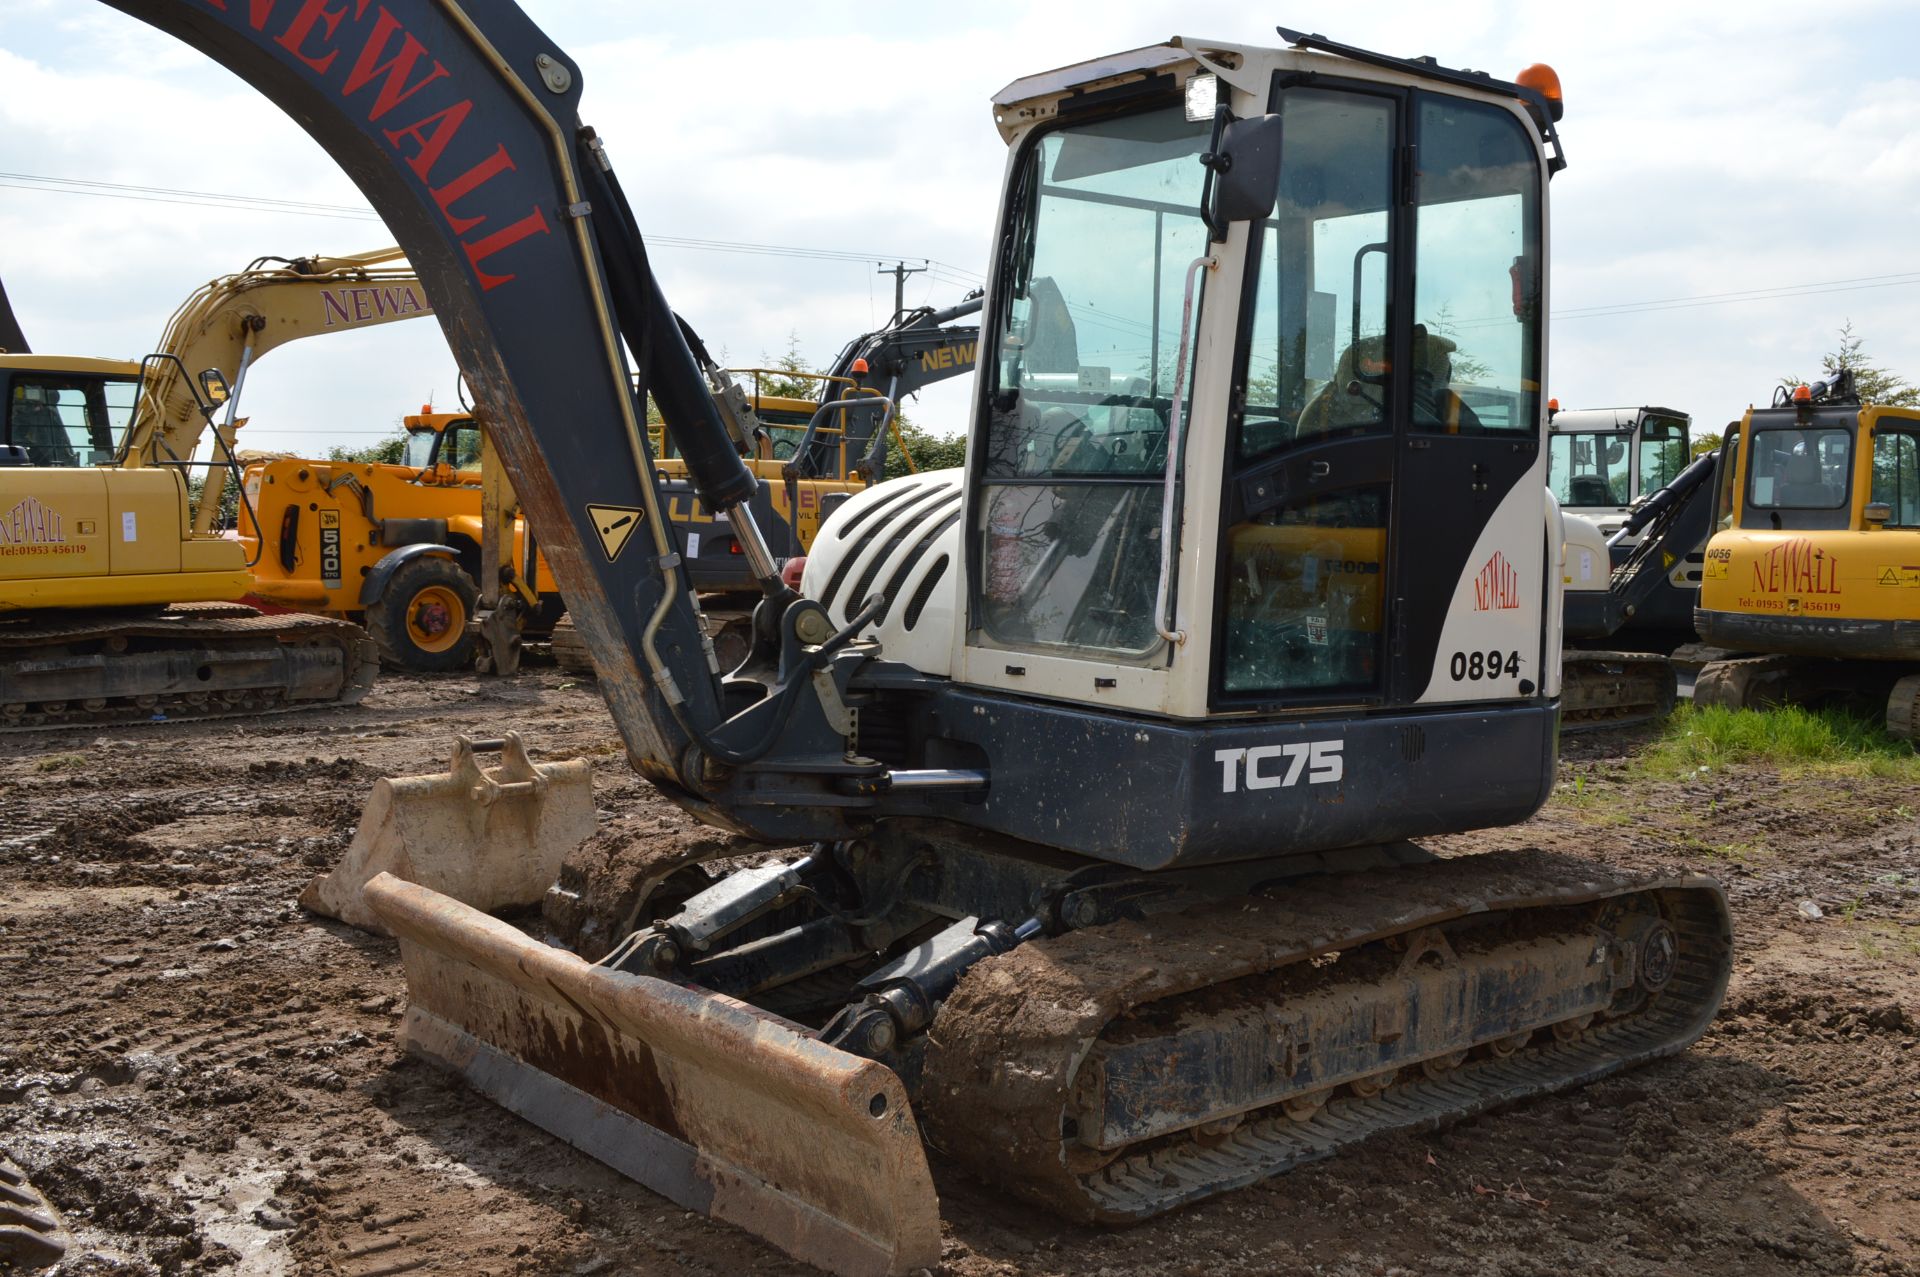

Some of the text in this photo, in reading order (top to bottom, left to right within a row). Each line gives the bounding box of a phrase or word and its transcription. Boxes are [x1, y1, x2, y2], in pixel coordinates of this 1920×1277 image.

[320, 287, 433, 326] NEWA
[922, 342, 979, 373] NEW
[52, 544, 87, 555] 456119
[323, 530, 339, 571] 540
[1707, 549, 1731, 559] 0056
[1752, 539, 1842, 594] NEWALL
[1474, 550, 1520, 611] NEWALL
[1739, 597, 1841, 613] Tel: 01953 456119
[1450, 650, 1520, 682] 0894
[1214, 739, 1344, 793] TC75
